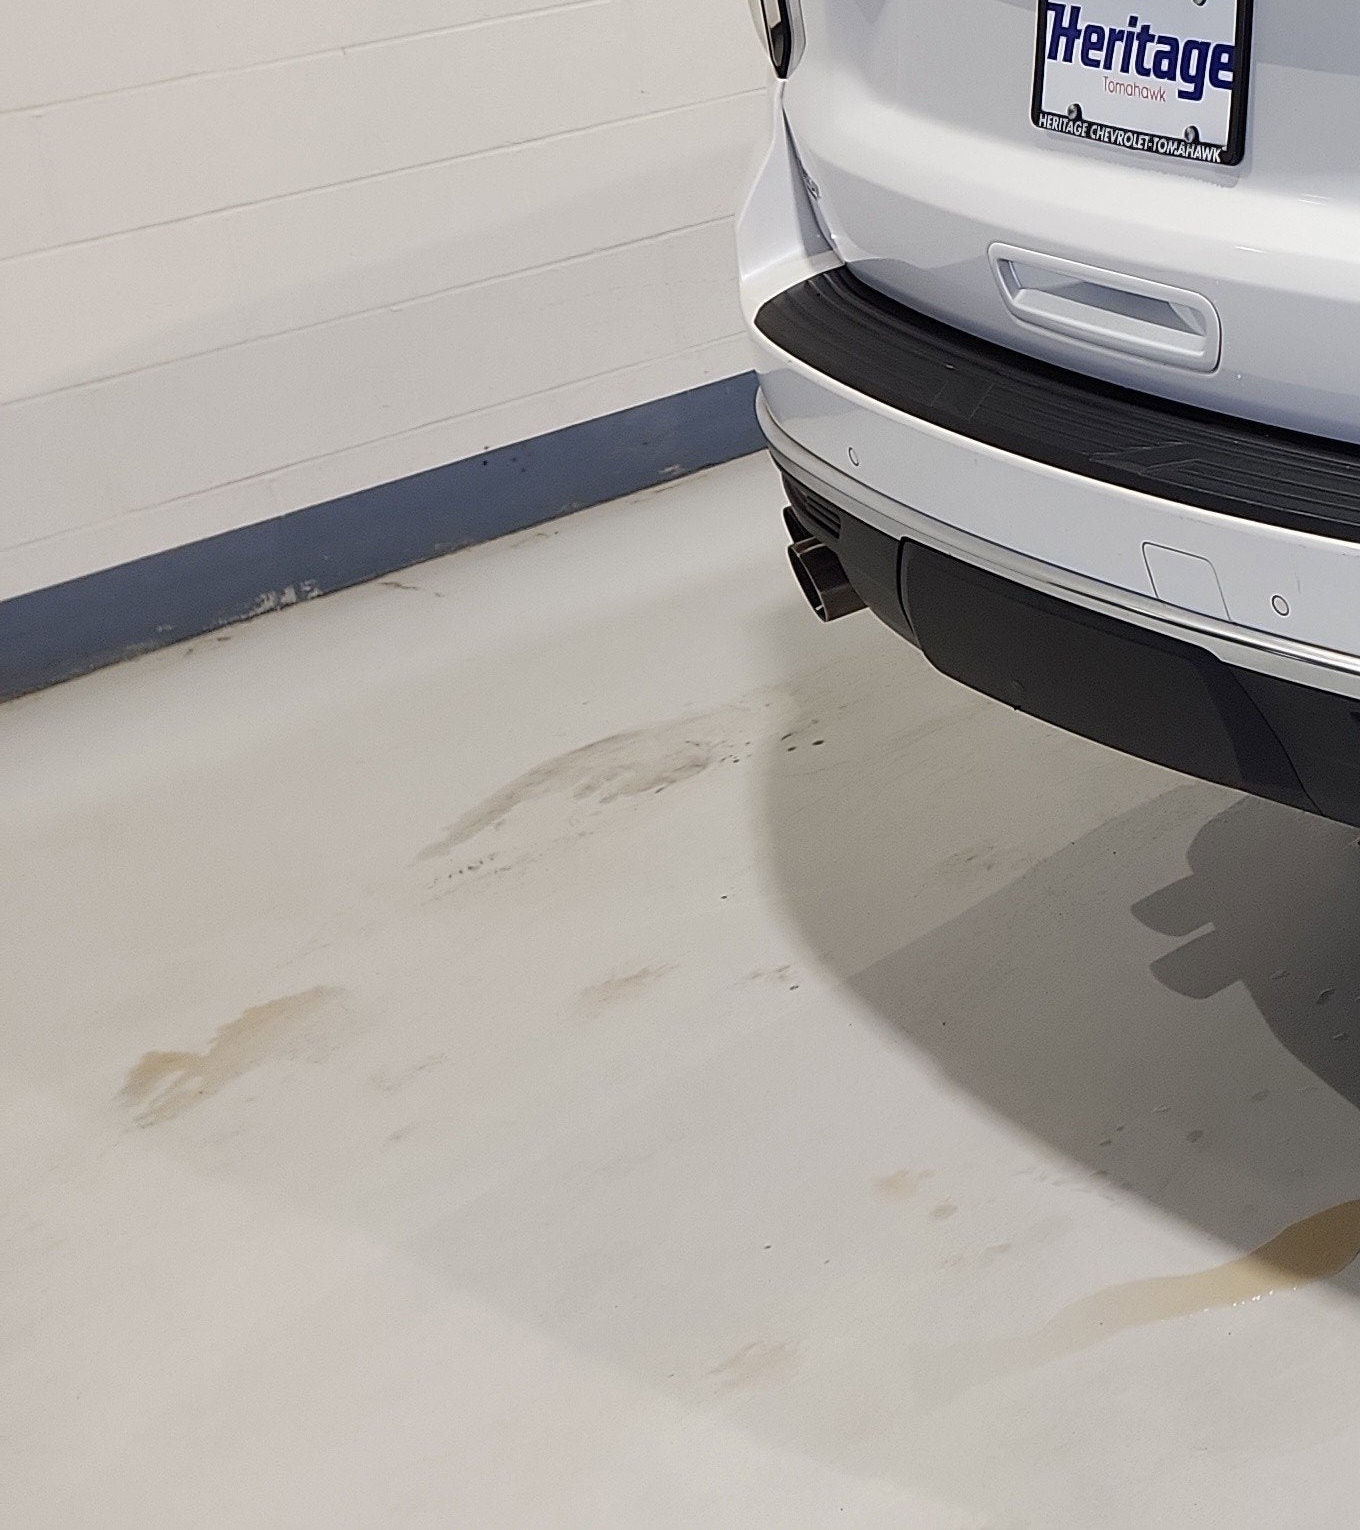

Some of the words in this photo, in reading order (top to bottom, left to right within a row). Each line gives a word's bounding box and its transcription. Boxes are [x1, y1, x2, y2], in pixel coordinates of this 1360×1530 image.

[1047, 2, 1237, 102] Heritage
[1102, 76, 1167, 102] Tomahawk
[1038, 113, 1089, 138] HERITAGE
[1090, 124, 1222, 163] CHEVROLET-TOMAHAWK
